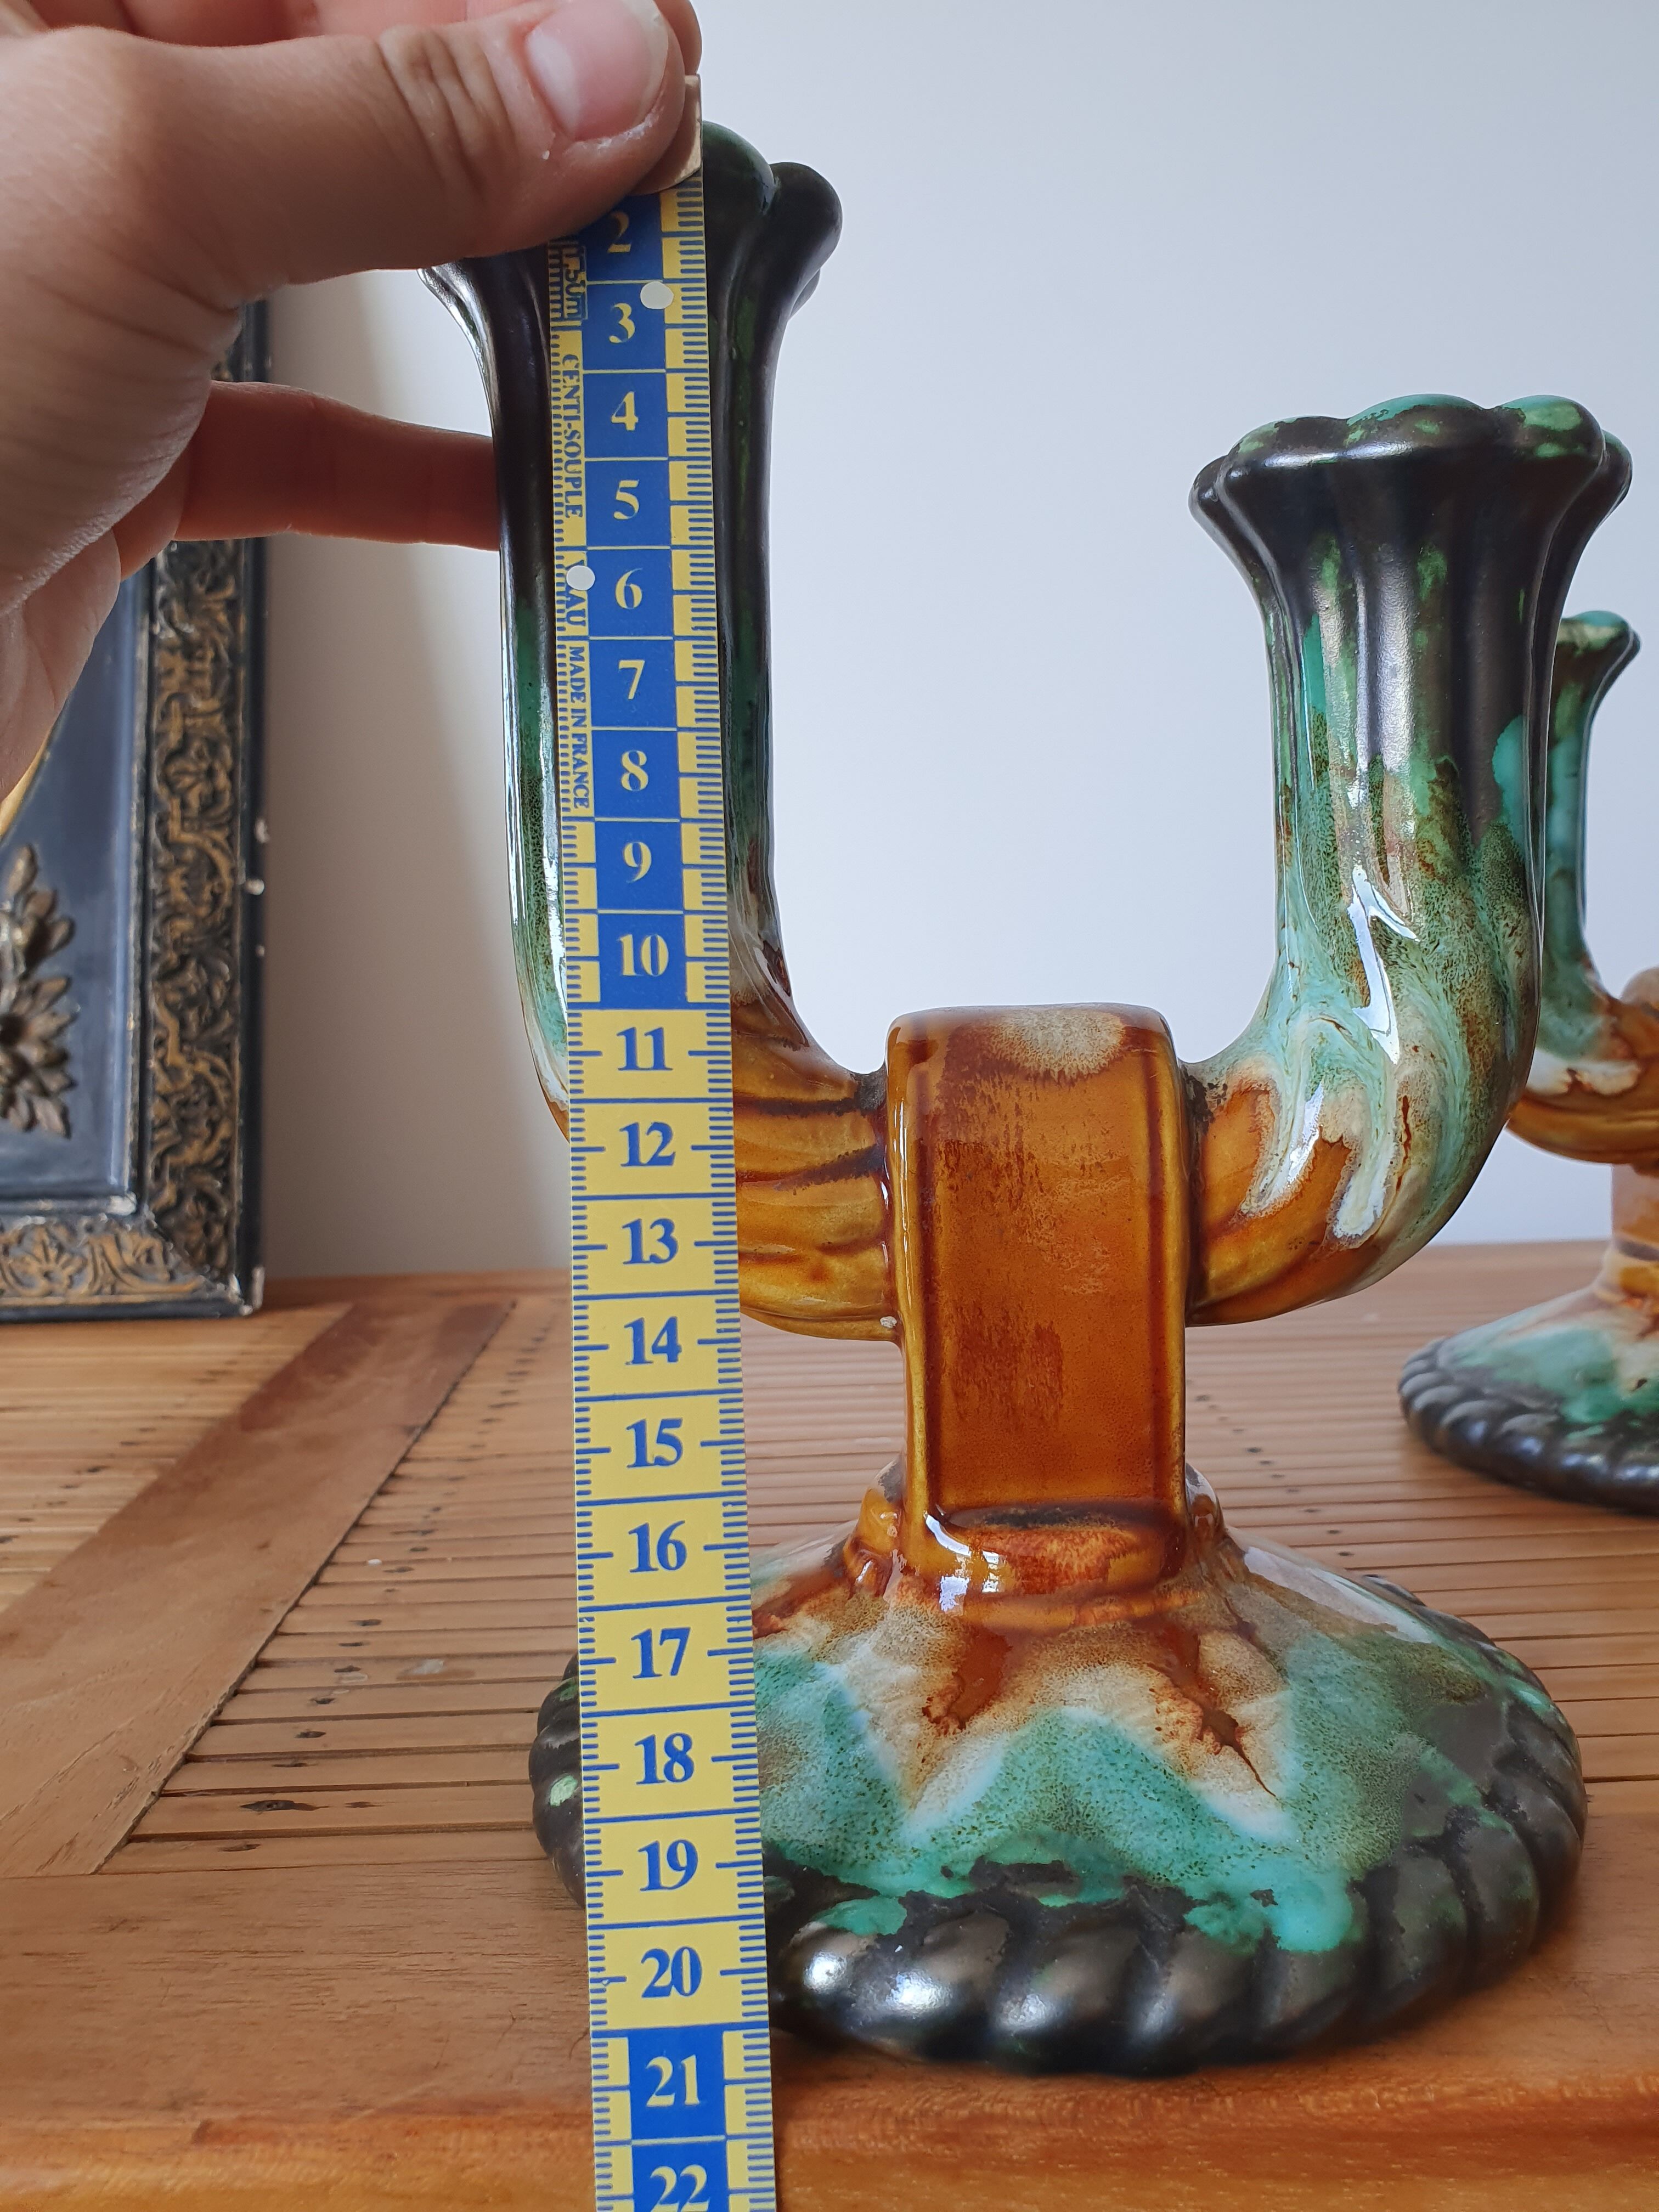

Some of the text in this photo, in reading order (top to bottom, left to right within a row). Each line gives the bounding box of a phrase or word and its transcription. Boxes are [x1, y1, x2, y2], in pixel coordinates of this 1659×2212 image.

[607, 211, 631, 253] 2
[609, 303, 635, 343] 3
[611, 392, 638, 431] 4
[563, 354, 583, 518] CENTI-SOUPLE
[614, 480, 639, 520] 5
[615, 567, 642, 609] 6
[618, 660, 644, 699] 7
[569, 646, 590, 809] MADE IN FRANCE
[621, 752, 648, 790] 8
[623, 841, 652, 883] 9
[618, 933, 669, 977] 10
[617, 1026, 673, 1071] 11
[620, 1121, 675, 1167] 12
[623, 1218, 678, 1265] 13
[624, 1317, 681, 1365] 14
[627, 1418, 682, 1469] 15
[629, 1521, 687, 1573] 16
[631, 1627, 690, 1679] 17
[635, 1733, 694, 1785] 18
[638, 1839, 698, 1892] 19
[641, 1946, 702, 1999] 20
[645, 2053, 700, 2107] 21
[649, 2164, 710, 2212] 22
